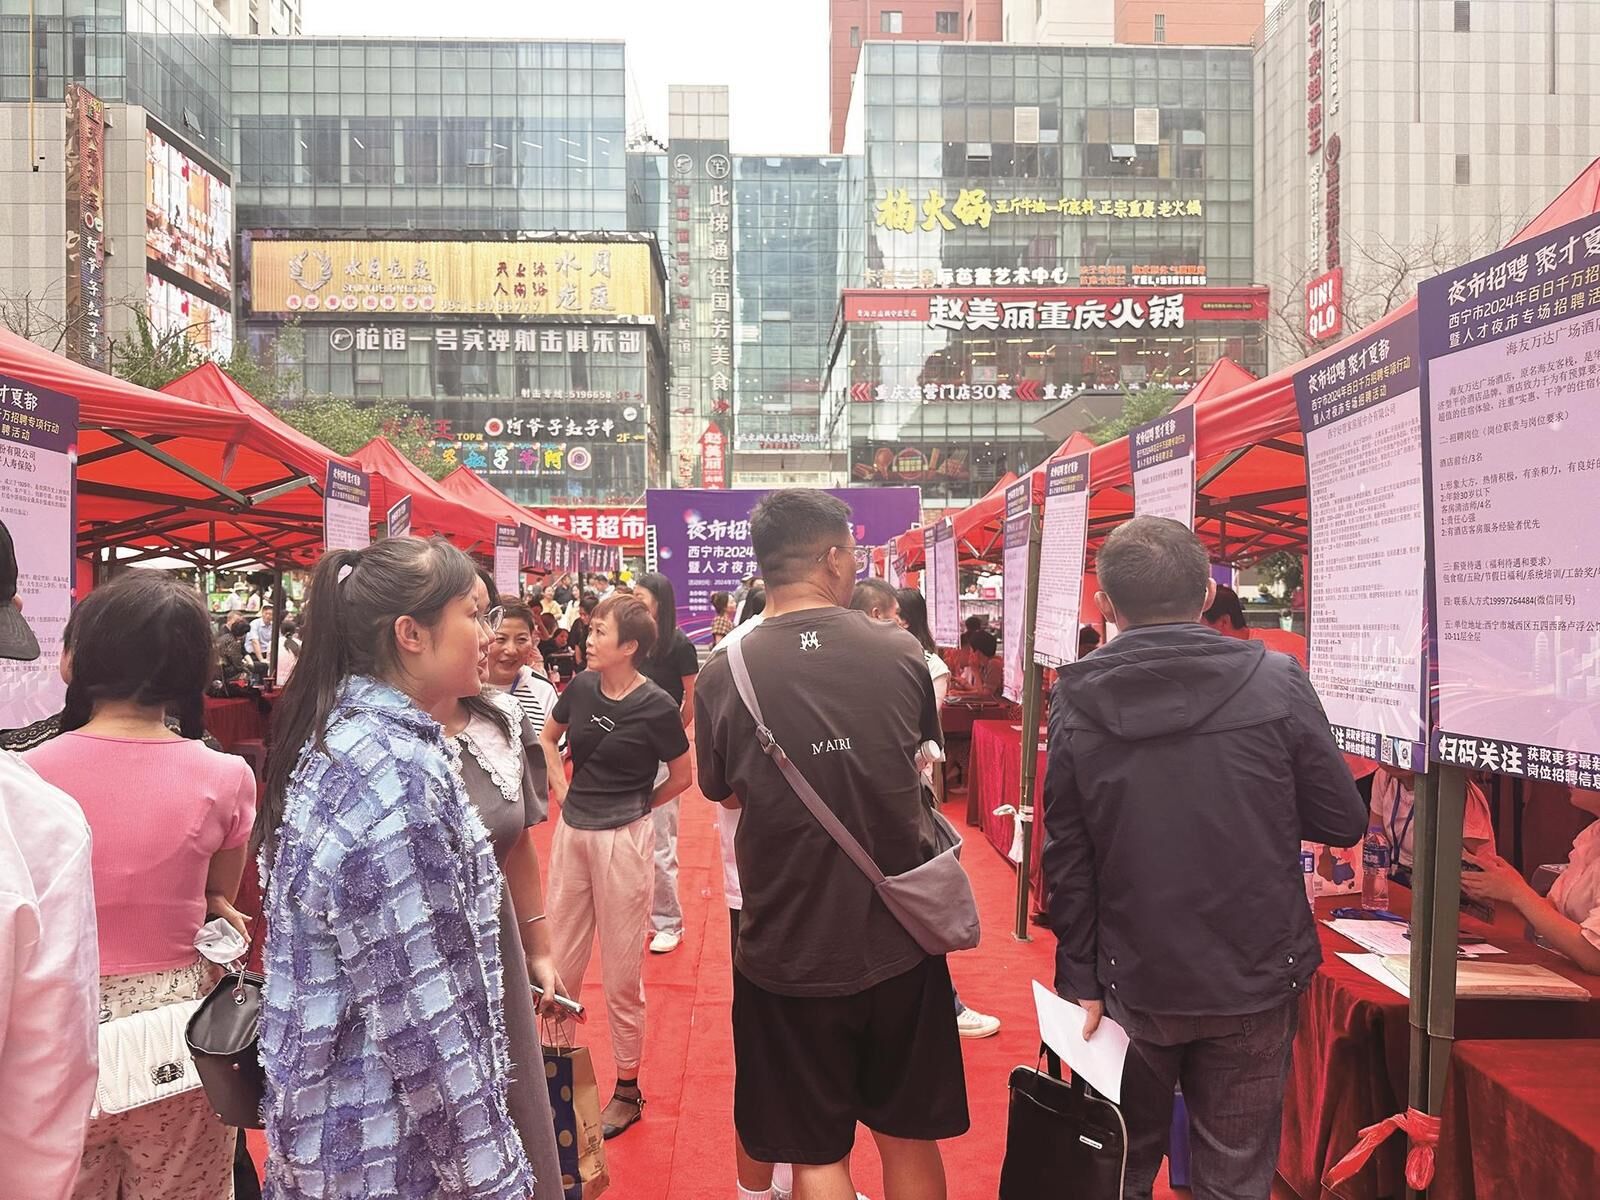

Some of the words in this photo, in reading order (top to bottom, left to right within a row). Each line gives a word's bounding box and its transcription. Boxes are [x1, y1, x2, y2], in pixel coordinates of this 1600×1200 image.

[708, 184, 730, 392] 此梯通往国芳美食
[1447, 253, 1529, 306] 夜市招聘
[928, 293, 1185, 331] 赵美丽重庆火锅
[1309, 305, 1336, 338] QLO
[355, 327, 641, 353] 枪馆一号实弹射击俱乐部
[874, 383, 1012, 401] 重庆在营门店30家
[1308, 359, 1346, 395] 夜市招聘
[0, 408, 60, 435] 万招聘专项行动
[688, 545, 754, 558] 西宁市2024
[688, 560, 758, 575] 暨人才夜市
[1439, 734, 1524, 775] 扫码关注
